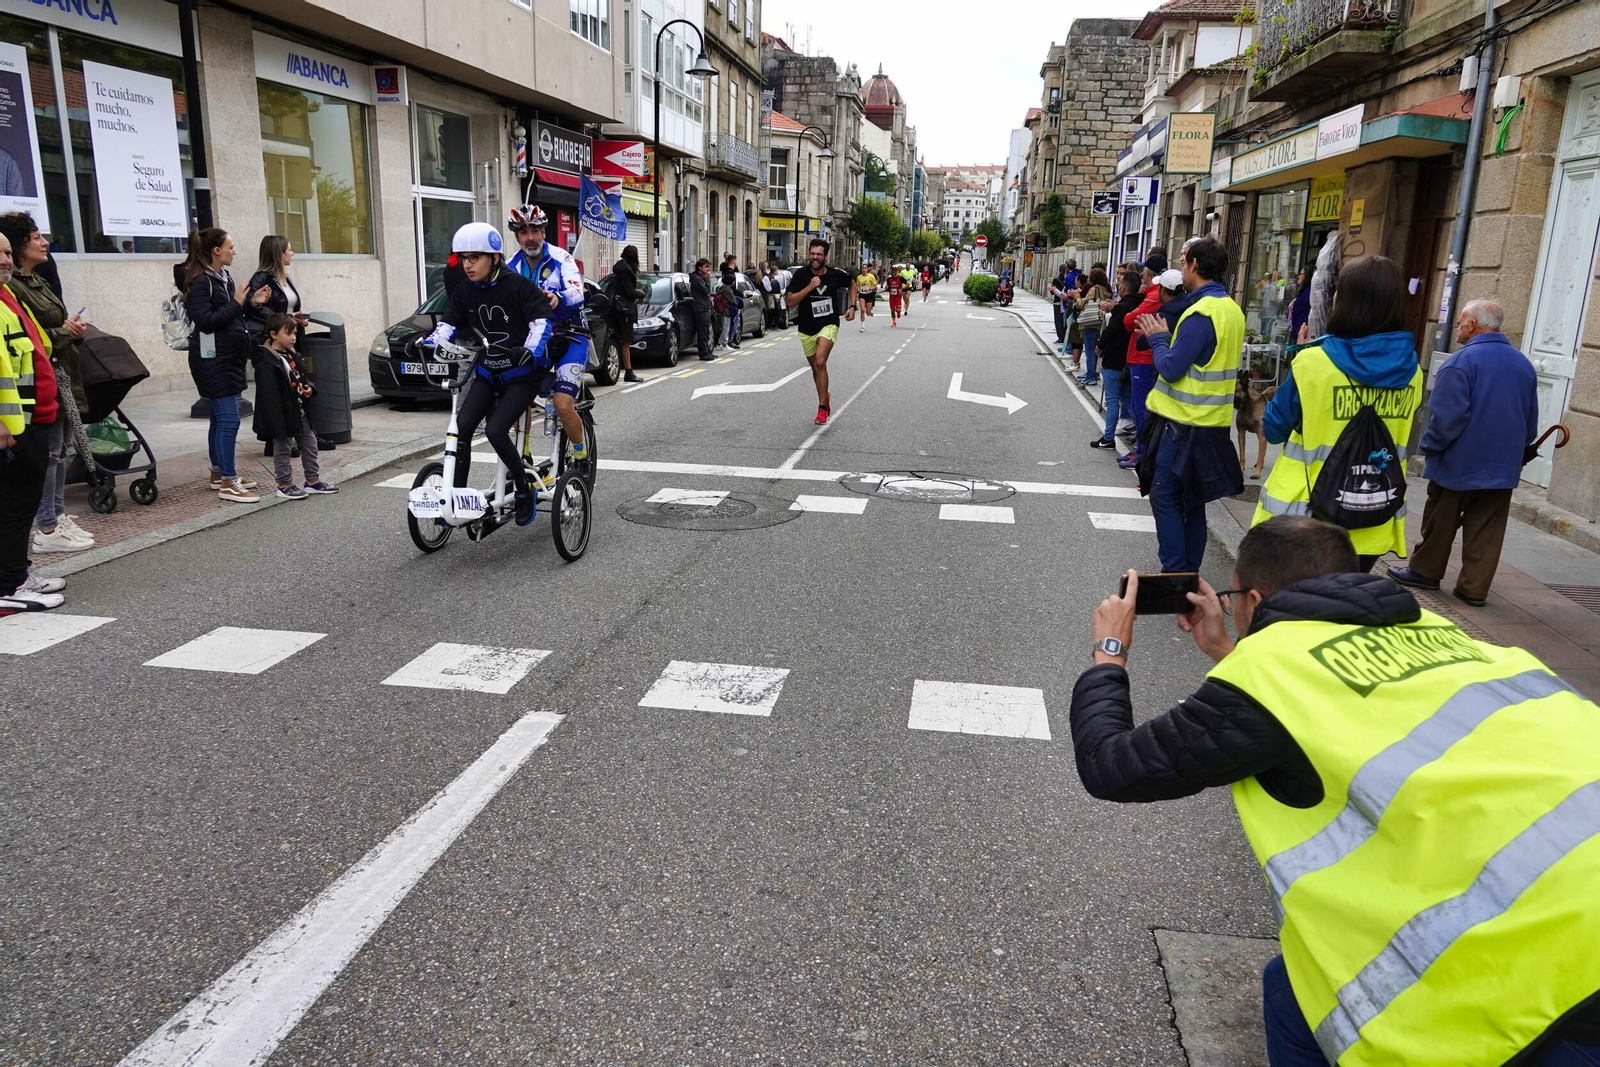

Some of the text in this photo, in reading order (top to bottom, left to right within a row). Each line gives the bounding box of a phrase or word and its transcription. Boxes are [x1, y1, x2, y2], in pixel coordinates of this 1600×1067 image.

[287, 53, 349, 88] ABANCA
[92, 81, 154, 106] Te cuidamos
[97, 118, 138, 133] muchos.
[1172, 119, 1212, 128] KIOSCO
[1342, 123, 1358, 140] VIGO
[1172, 131, 1210, 140] FLORA
[553, 136, 591, 168] BARBERÍA
[621, 150, 642, 159] Cajero
[1244, 149, 1267, 176] KIOSCO
[1267, 138, 1298, 169] FLORA
[133, 161, 165, 179] Seguro
[135, 178, 173, 193] de Salud
[1308, 194, 1342, 218] FLOR
[140, 218, 166, 226] ABANCA
[406, 364, 447, 374] 979 FJX
